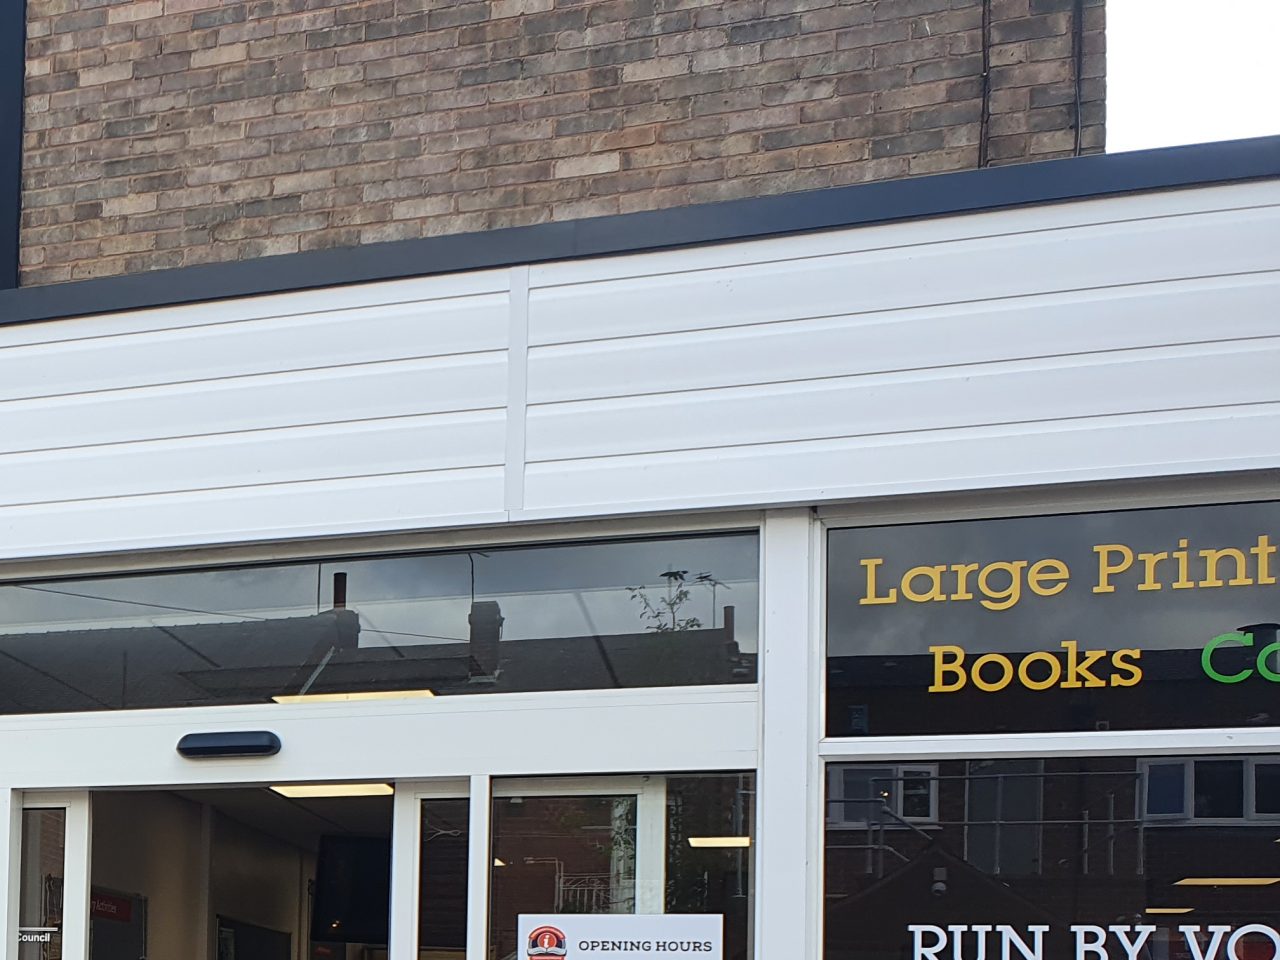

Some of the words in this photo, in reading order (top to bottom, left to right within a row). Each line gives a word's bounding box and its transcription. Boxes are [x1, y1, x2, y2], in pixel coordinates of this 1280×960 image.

[860, 558, 1070, 611] Large
[1092, 535, 1277, 593] Print
[928, 640, 1143, 693] Books
[578, 939, 652, 952] OPENING
[656, 940, 713, 952] HOURS
